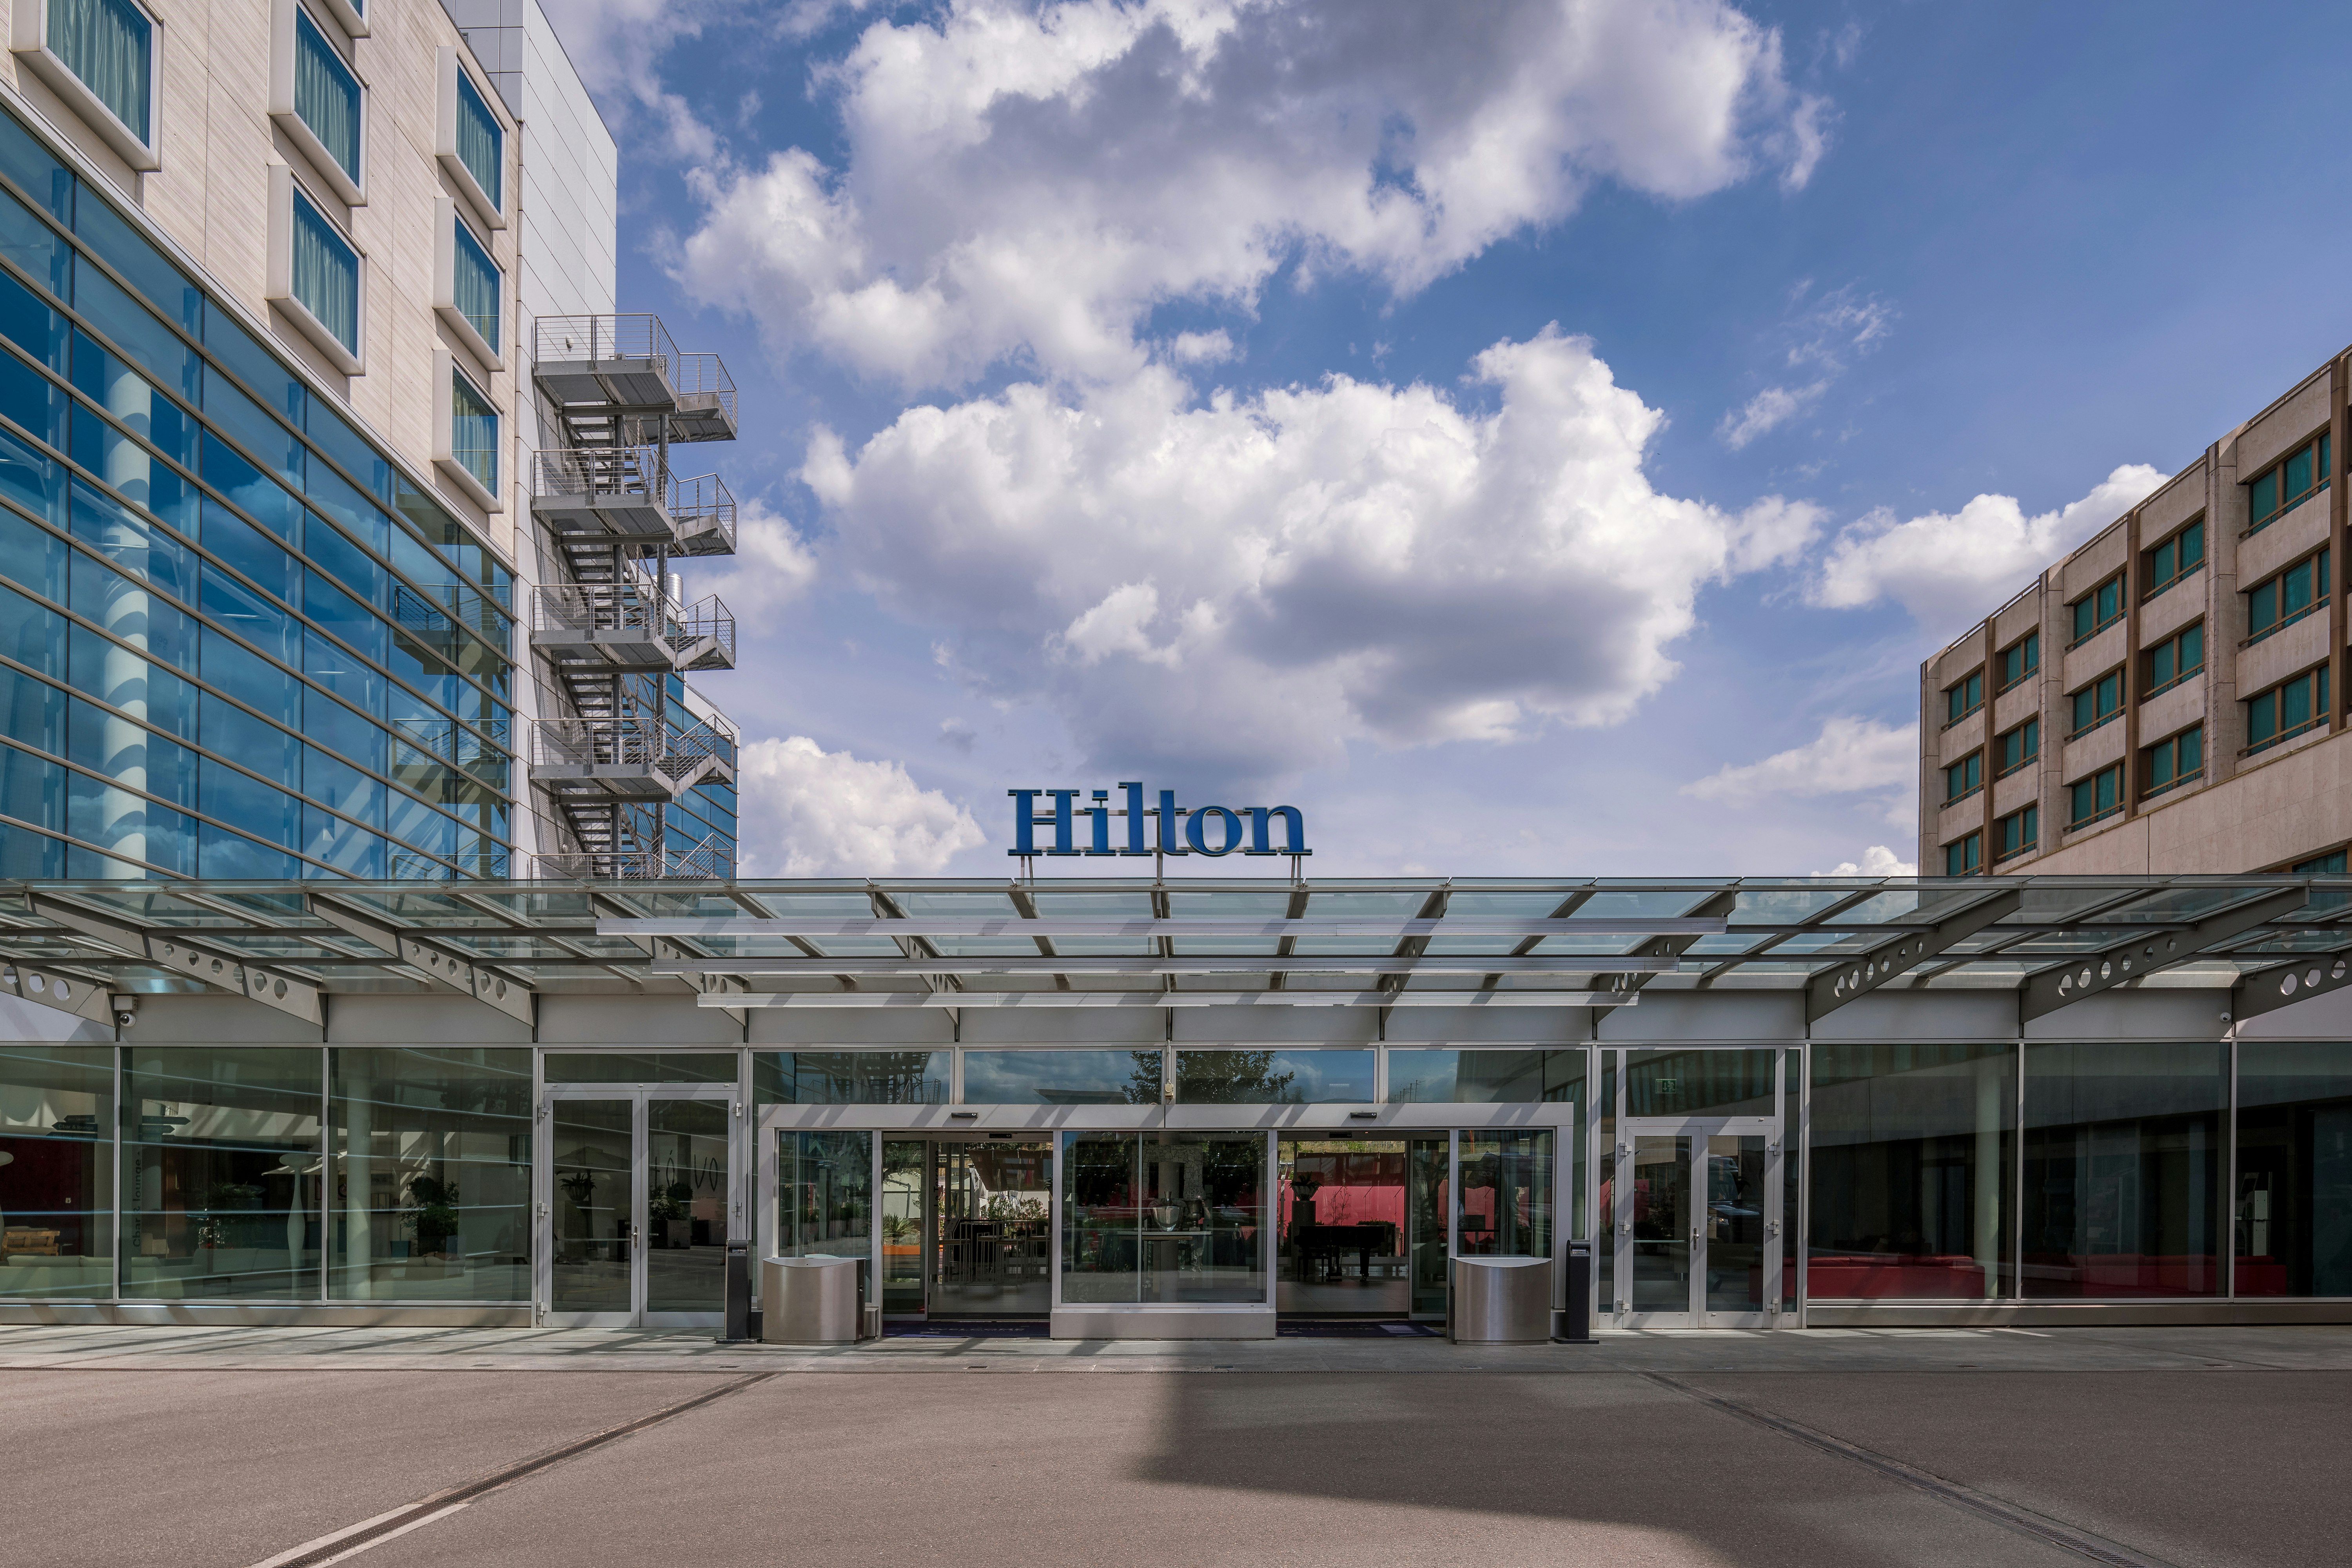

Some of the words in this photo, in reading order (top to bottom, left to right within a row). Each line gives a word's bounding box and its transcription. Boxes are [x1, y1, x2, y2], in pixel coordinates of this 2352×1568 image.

[1007, 781, 1312, 856] Hilton
[132, 1159, 142, 1202] lounge
[132, 1218, 141, 1247] Cbar
